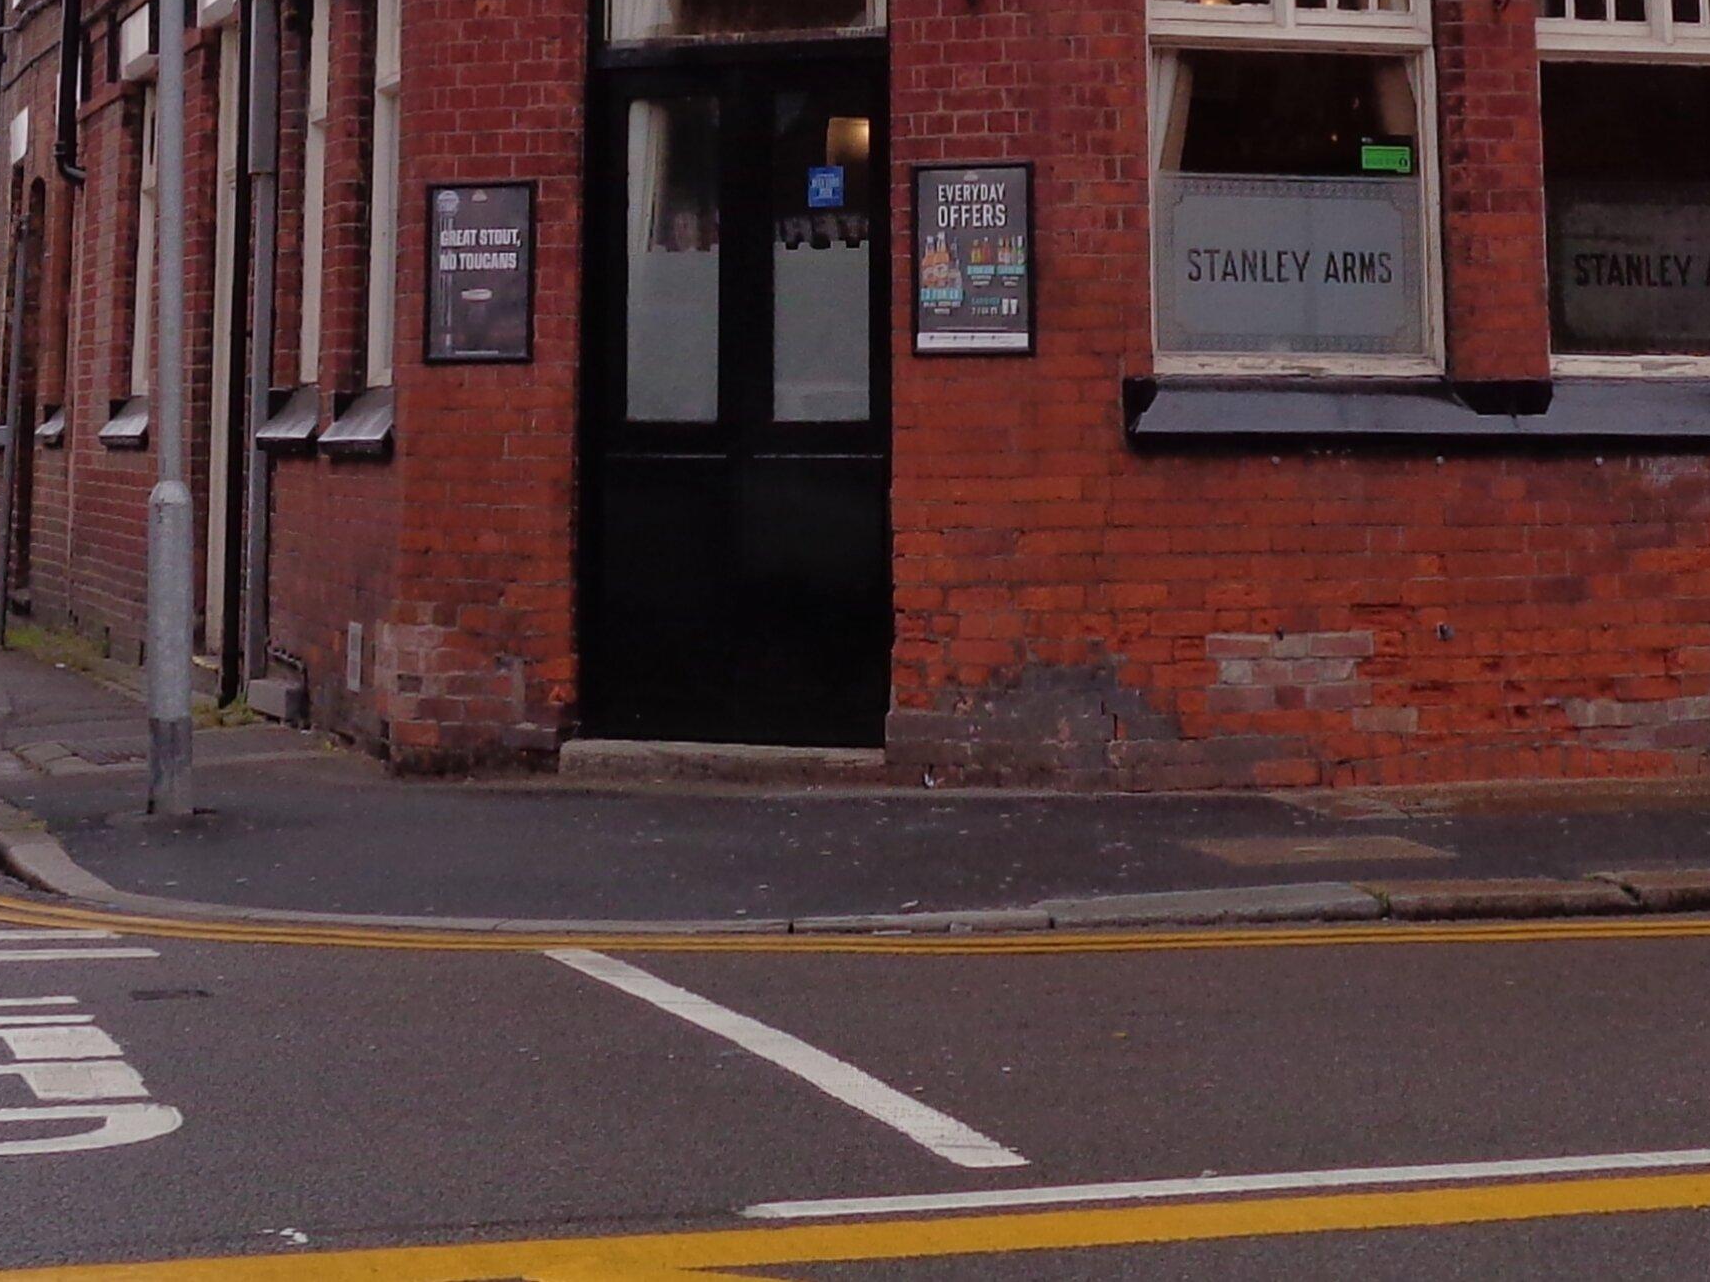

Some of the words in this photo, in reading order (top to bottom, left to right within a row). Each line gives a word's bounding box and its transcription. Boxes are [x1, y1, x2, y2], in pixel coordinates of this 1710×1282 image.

[937, 183, 1006, 202] EVERYDAY
[937, 204, 1007, 227] OFFERS
[440, 229, 478, 247] GREAT
[440, 252, 457, 271] NO
[459, 252, 518, 271] TOUCANS
[1188, 247, 1311, 285] STANLEY
[1324, 250, 1393, 285] ARMS
[1574, 253, 1692, 287] STANLEY
